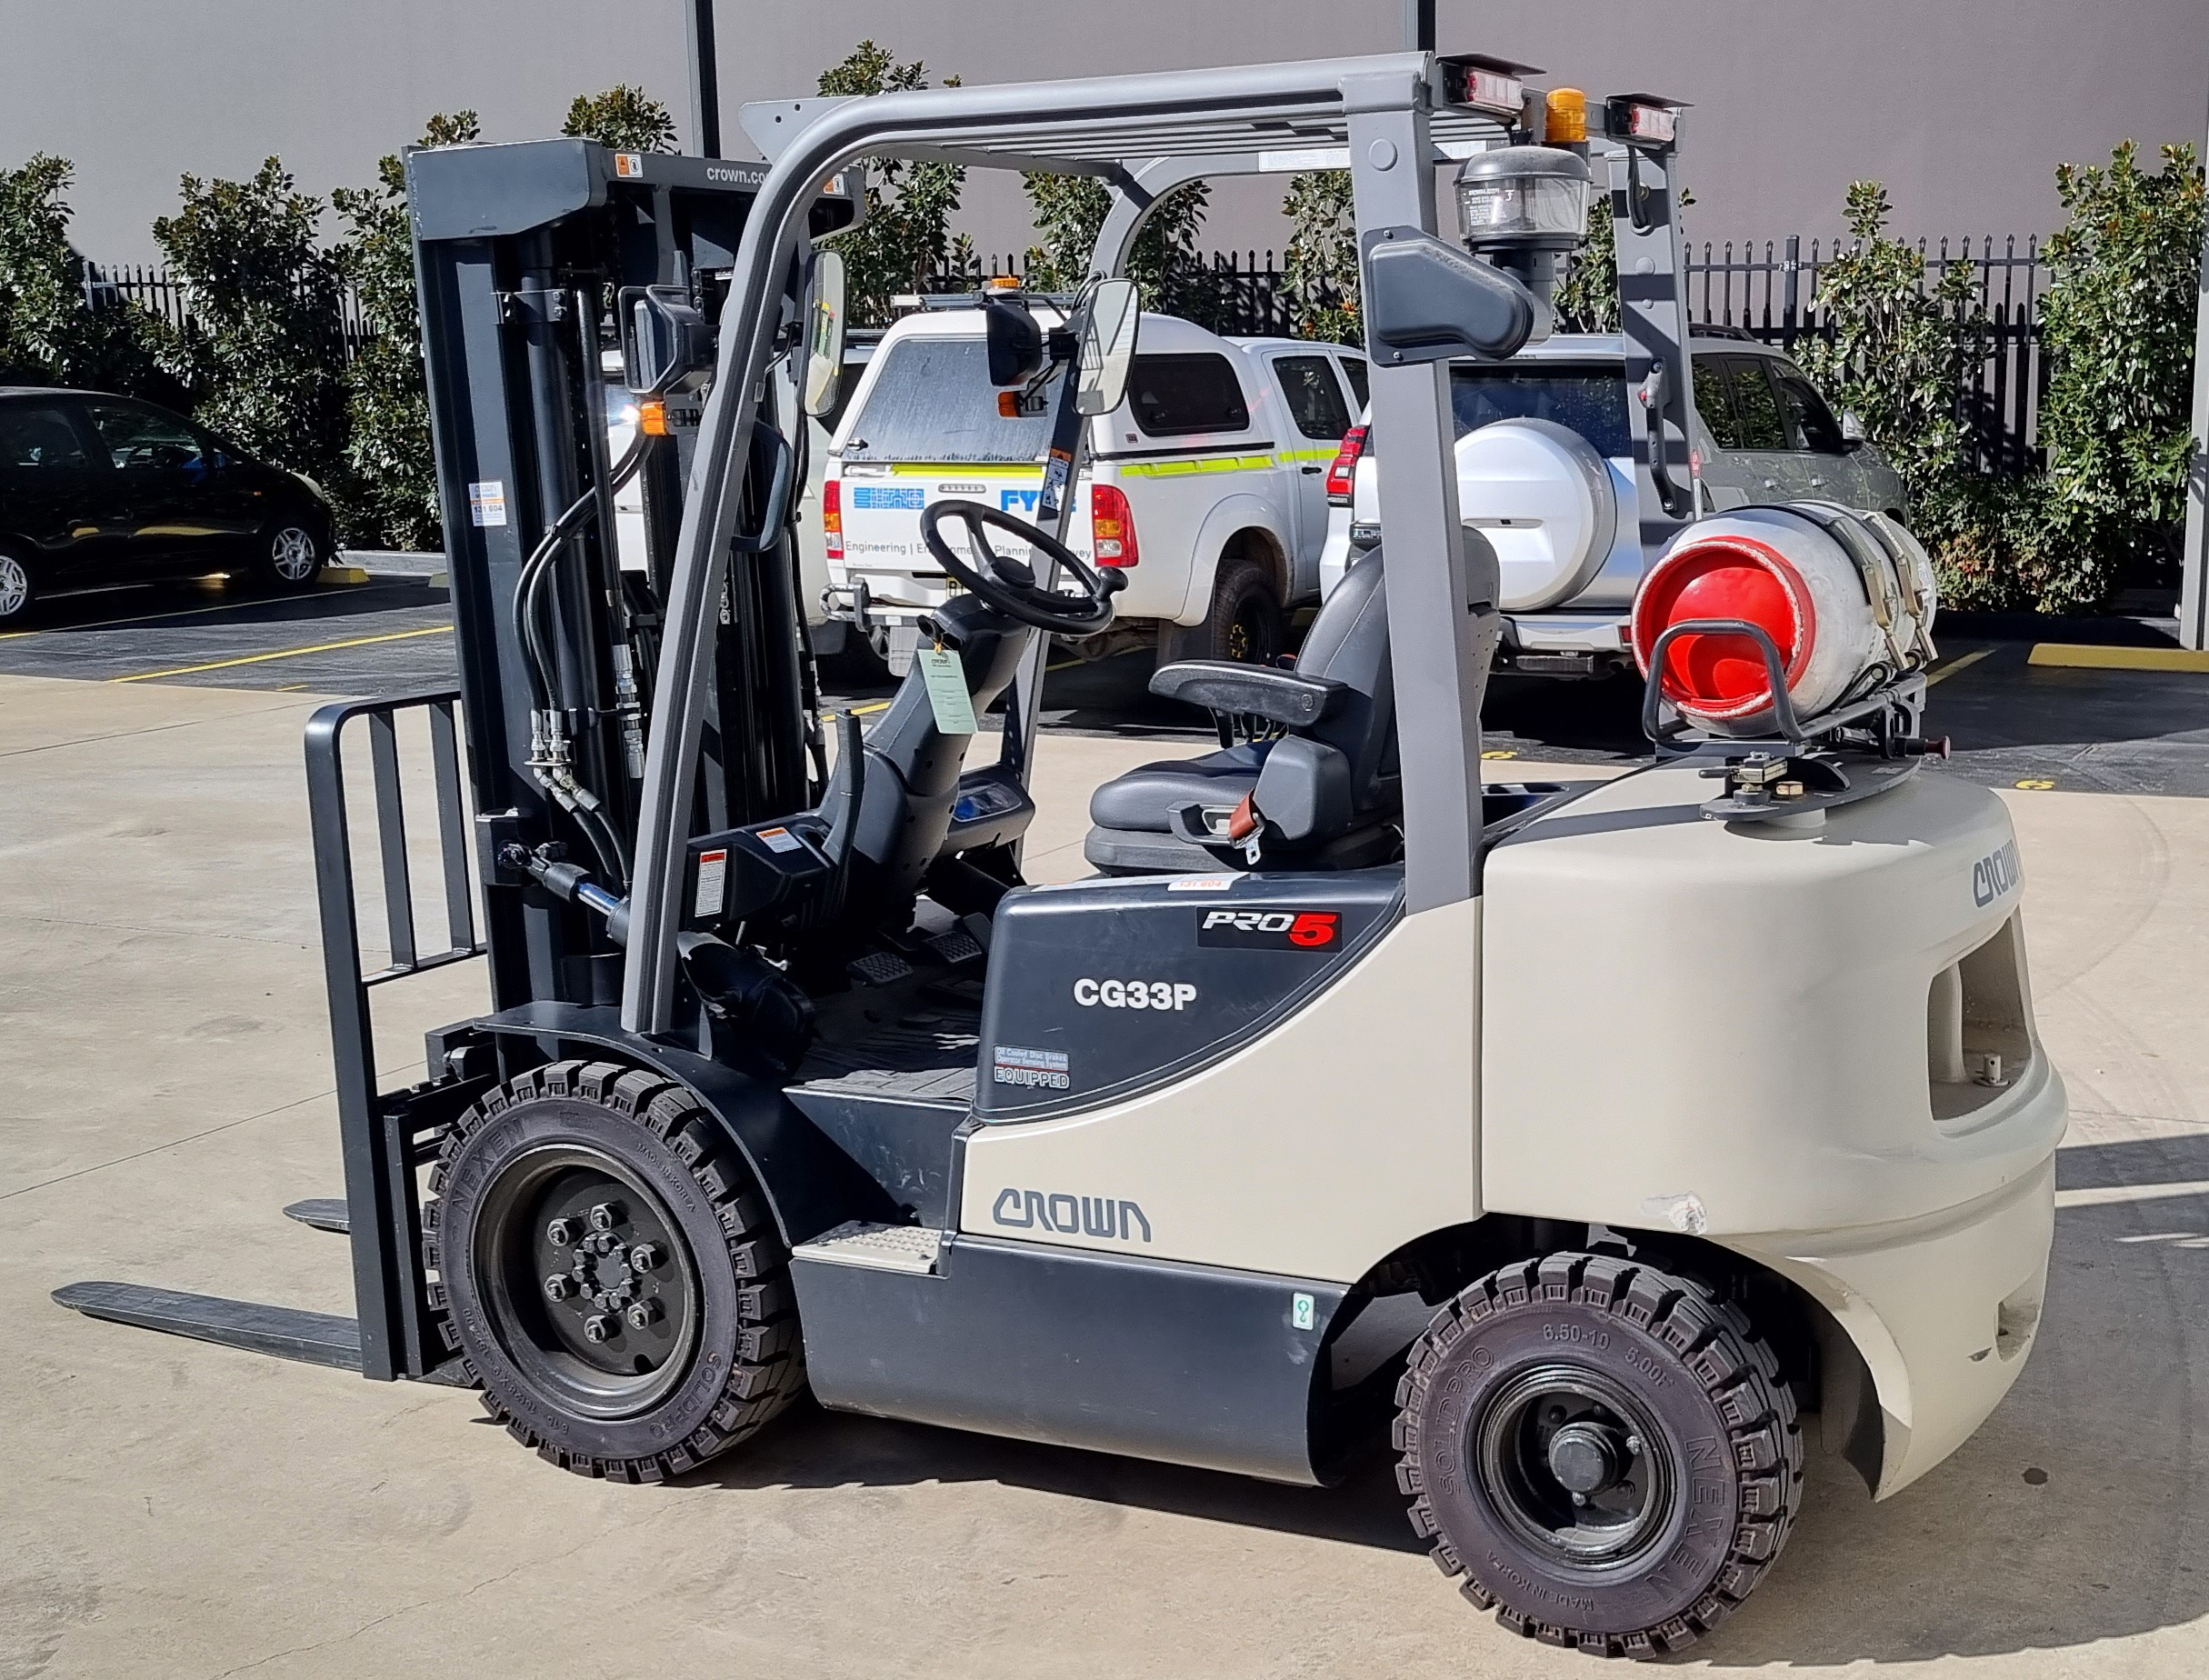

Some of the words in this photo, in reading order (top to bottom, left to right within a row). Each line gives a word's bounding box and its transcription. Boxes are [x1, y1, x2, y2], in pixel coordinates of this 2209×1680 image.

[706, 167, 769, 185] crown.co
[845, 541, 906, 555] Engineering
[1074, 978, 1197, 1011] CG33P
[994, 1065, 1070, 1089] EQUIPPED
[993, 1188, 1152, 1243] CROWN
[1543, 1323, 1612, 1351] 6.50-10
